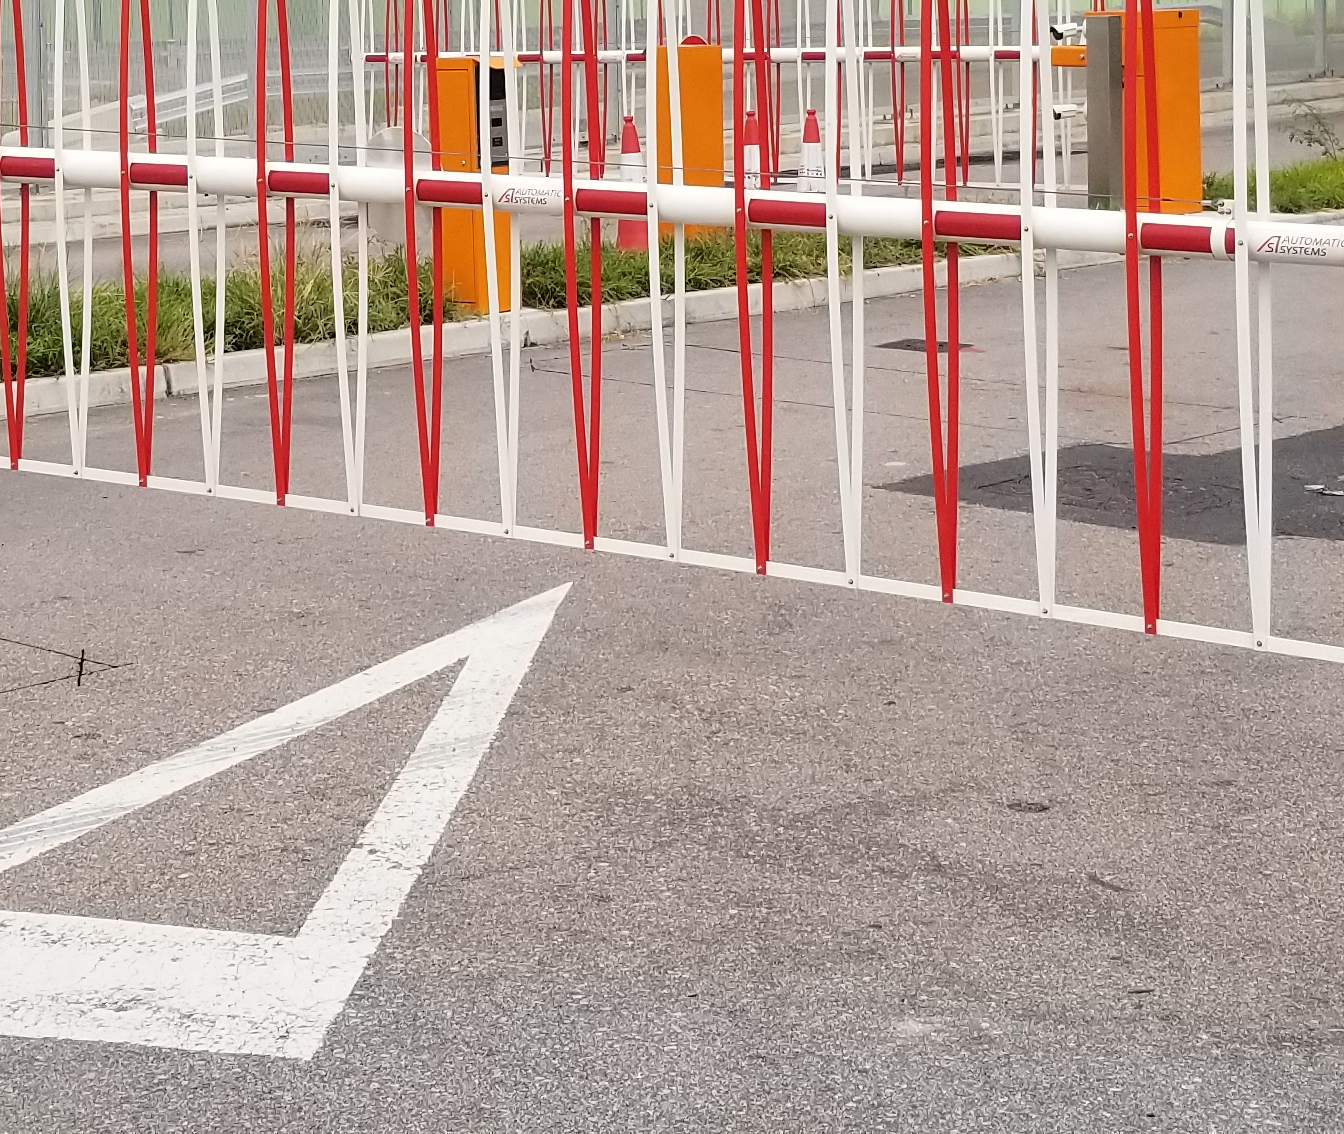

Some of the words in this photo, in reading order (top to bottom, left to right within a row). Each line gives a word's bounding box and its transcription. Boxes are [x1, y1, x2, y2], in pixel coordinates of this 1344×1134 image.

[516, 188, 562, 198] AUTOMATIC
[514, 197, 547, 205] SYSTEMS
[1279, 245, 1327, 257] SYSTEMS
